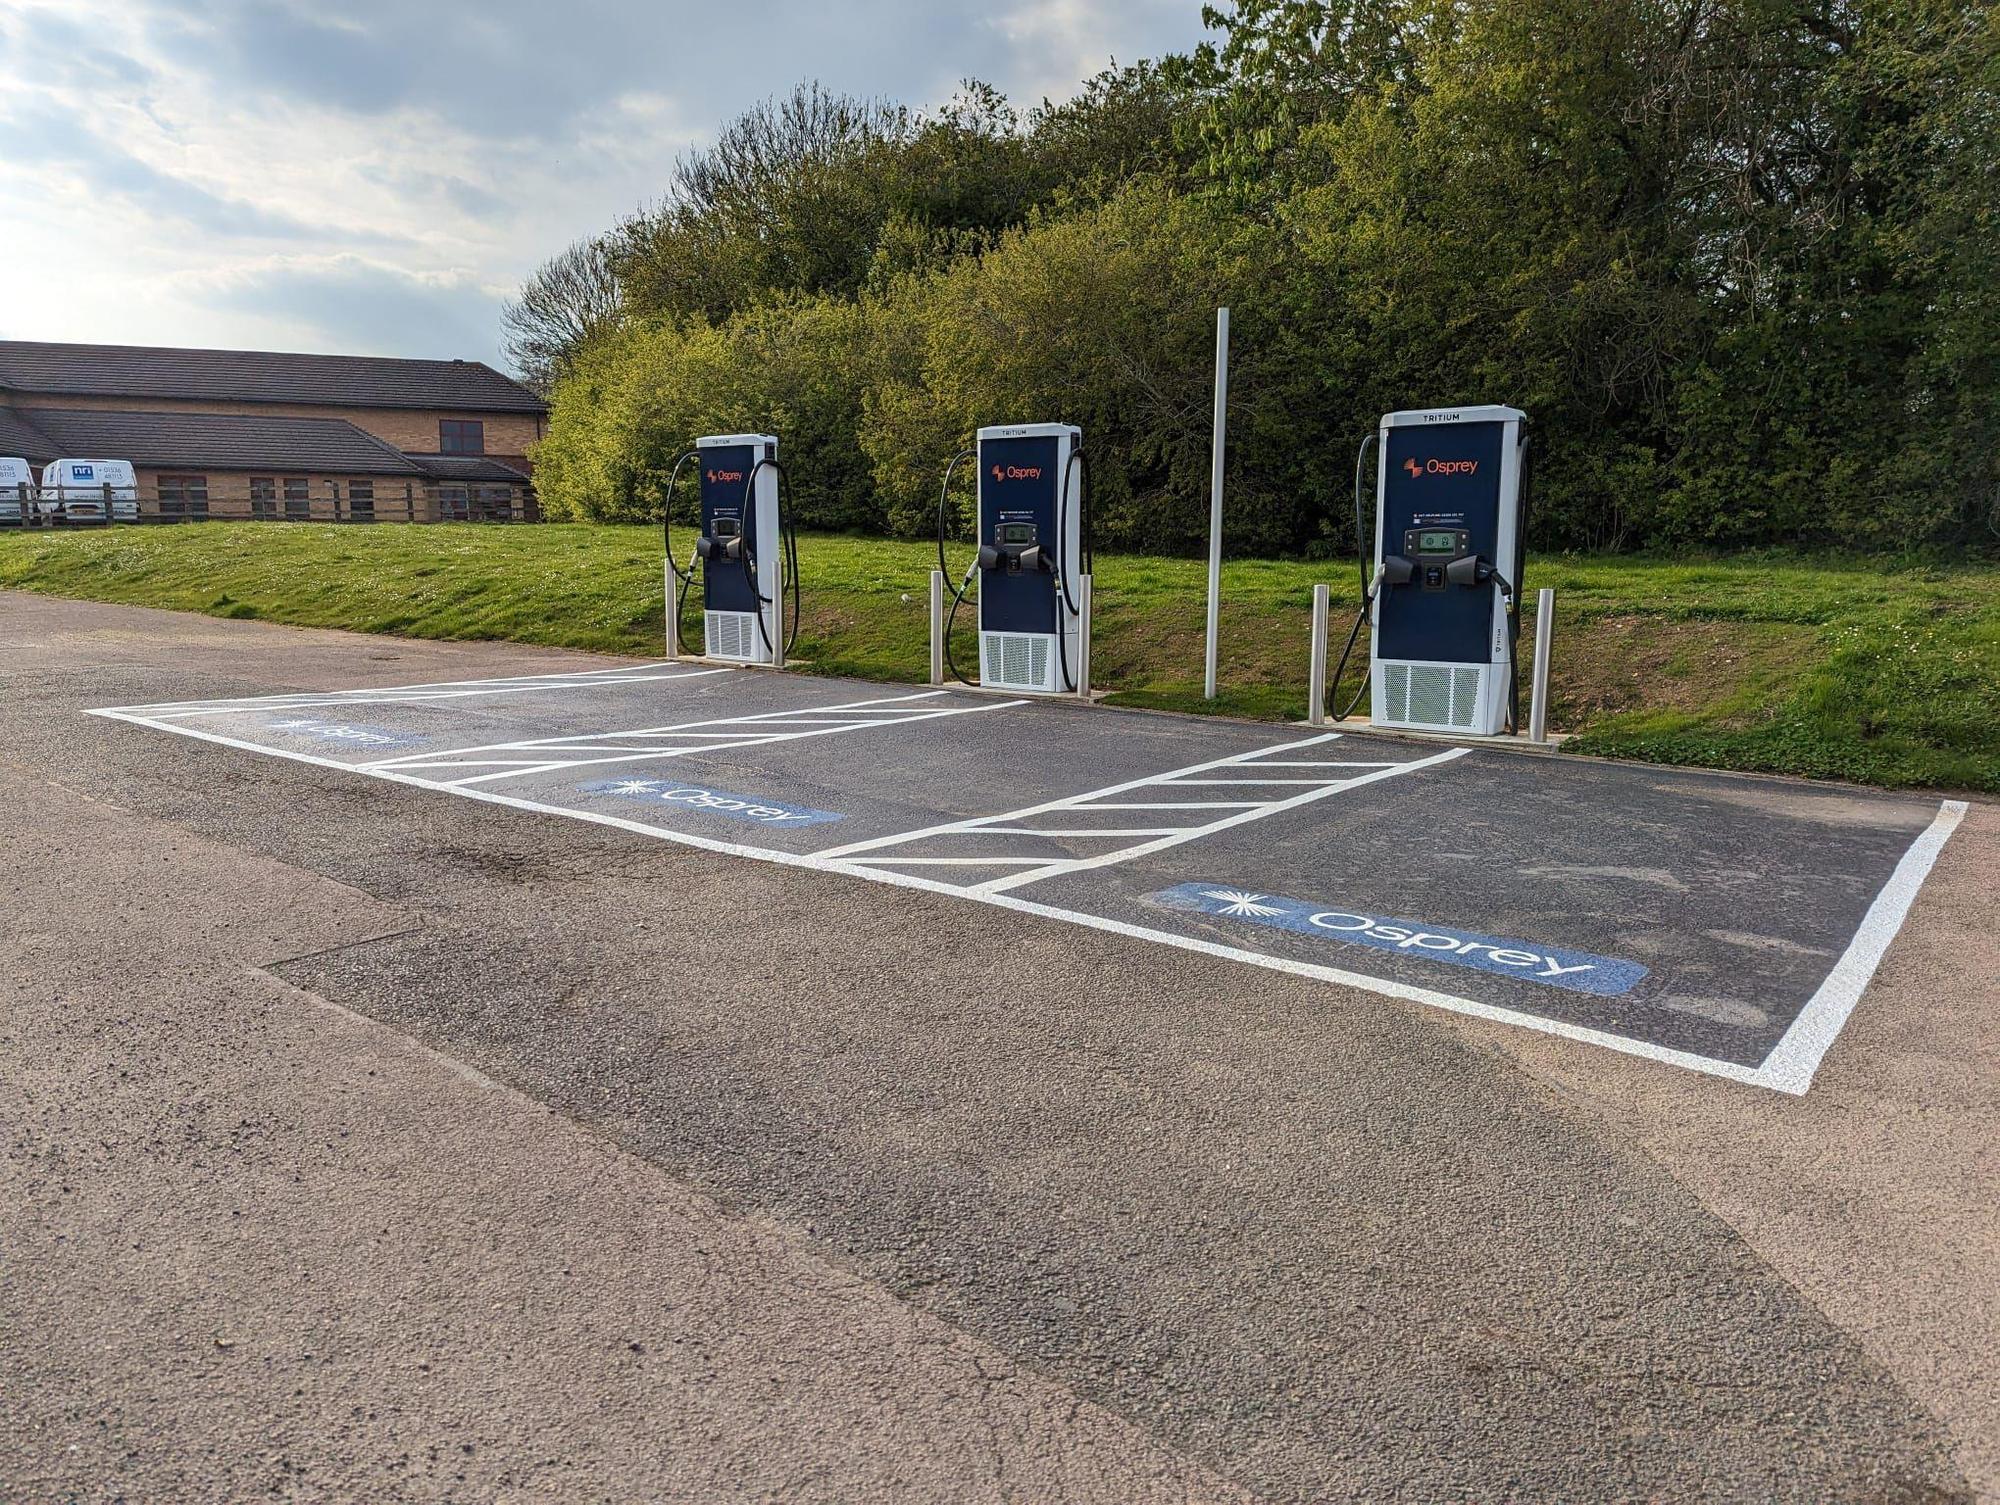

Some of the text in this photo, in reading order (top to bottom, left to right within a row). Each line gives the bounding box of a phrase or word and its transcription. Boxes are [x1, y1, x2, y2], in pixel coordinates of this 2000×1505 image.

[1423, 413, 1460, 422] TRITIUM
[74, 466, 92, 475] nri
[1006, 466, 1042, 480] Osprey
[1427, 458, 1479, 476] Osprey
[717, 470, 743, 483] Osprey
[661, 788, 811, 822] Osprey
[1308, 911, 1595, 977] Osprey
